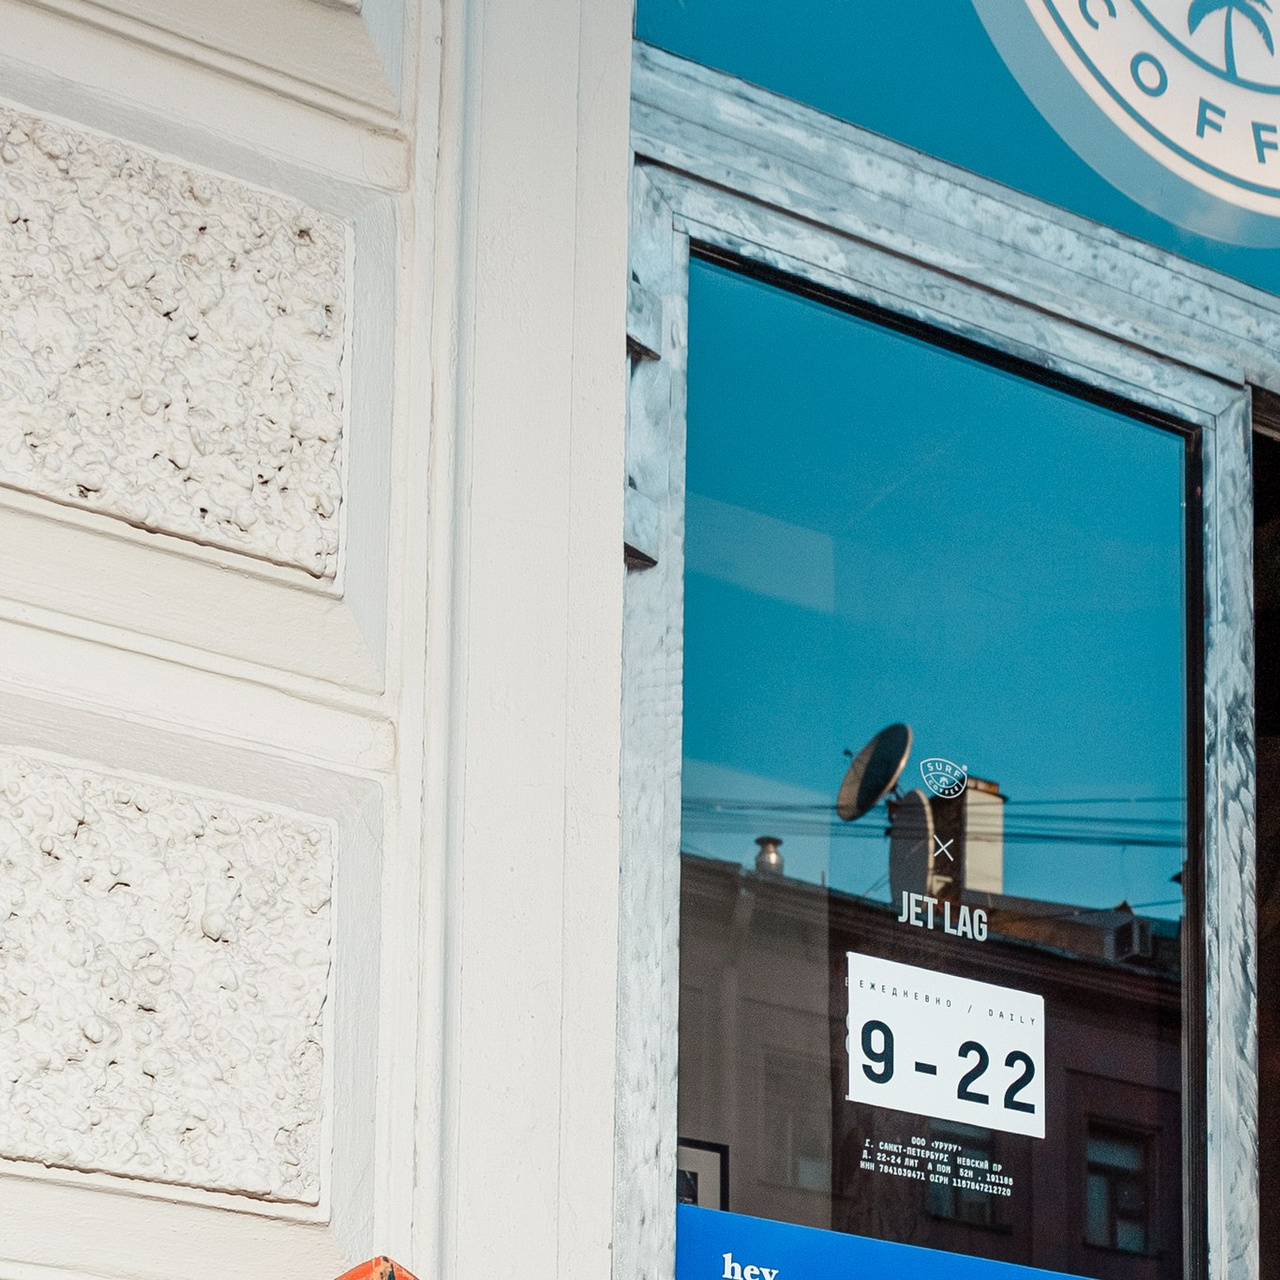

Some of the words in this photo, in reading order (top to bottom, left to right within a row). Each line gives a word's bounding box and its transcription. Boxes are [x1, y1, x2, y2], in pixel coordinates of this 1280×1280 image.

[927, 762, 961, 777] SURF
[898, 891, 938, 930] JET
[944, 901, 988, 942] LAG
[859, 979, 952, 1008] ЕЖЕДНЕВНО
[988, 1008, 1036, 1026] DAILY
[861, 1019, 895, 1084] 9
[957, 1040, 1036, 1115] 22
[911, 1136, 926, 1147] ООО
[862, 1149, 871, 1160] Д.
[876, 1152, 901, 1165] 22-24
[904, 1157, 919, 1168] ЛИТ
[927, 1161, 933, 1171] А
[936, 1163, 951, 1174] ПОМ
[878, 1141, 949, 1163] САНКТ-ПЕТЕРБУРГ
[957, 1156, 989, 1170] НЕВСКИЙ
[992, 1163, 1003, 1173] ПР
[860, 1160, 875, 1171] ИНН
[929, 1173, 949, 1185] ОГРН
